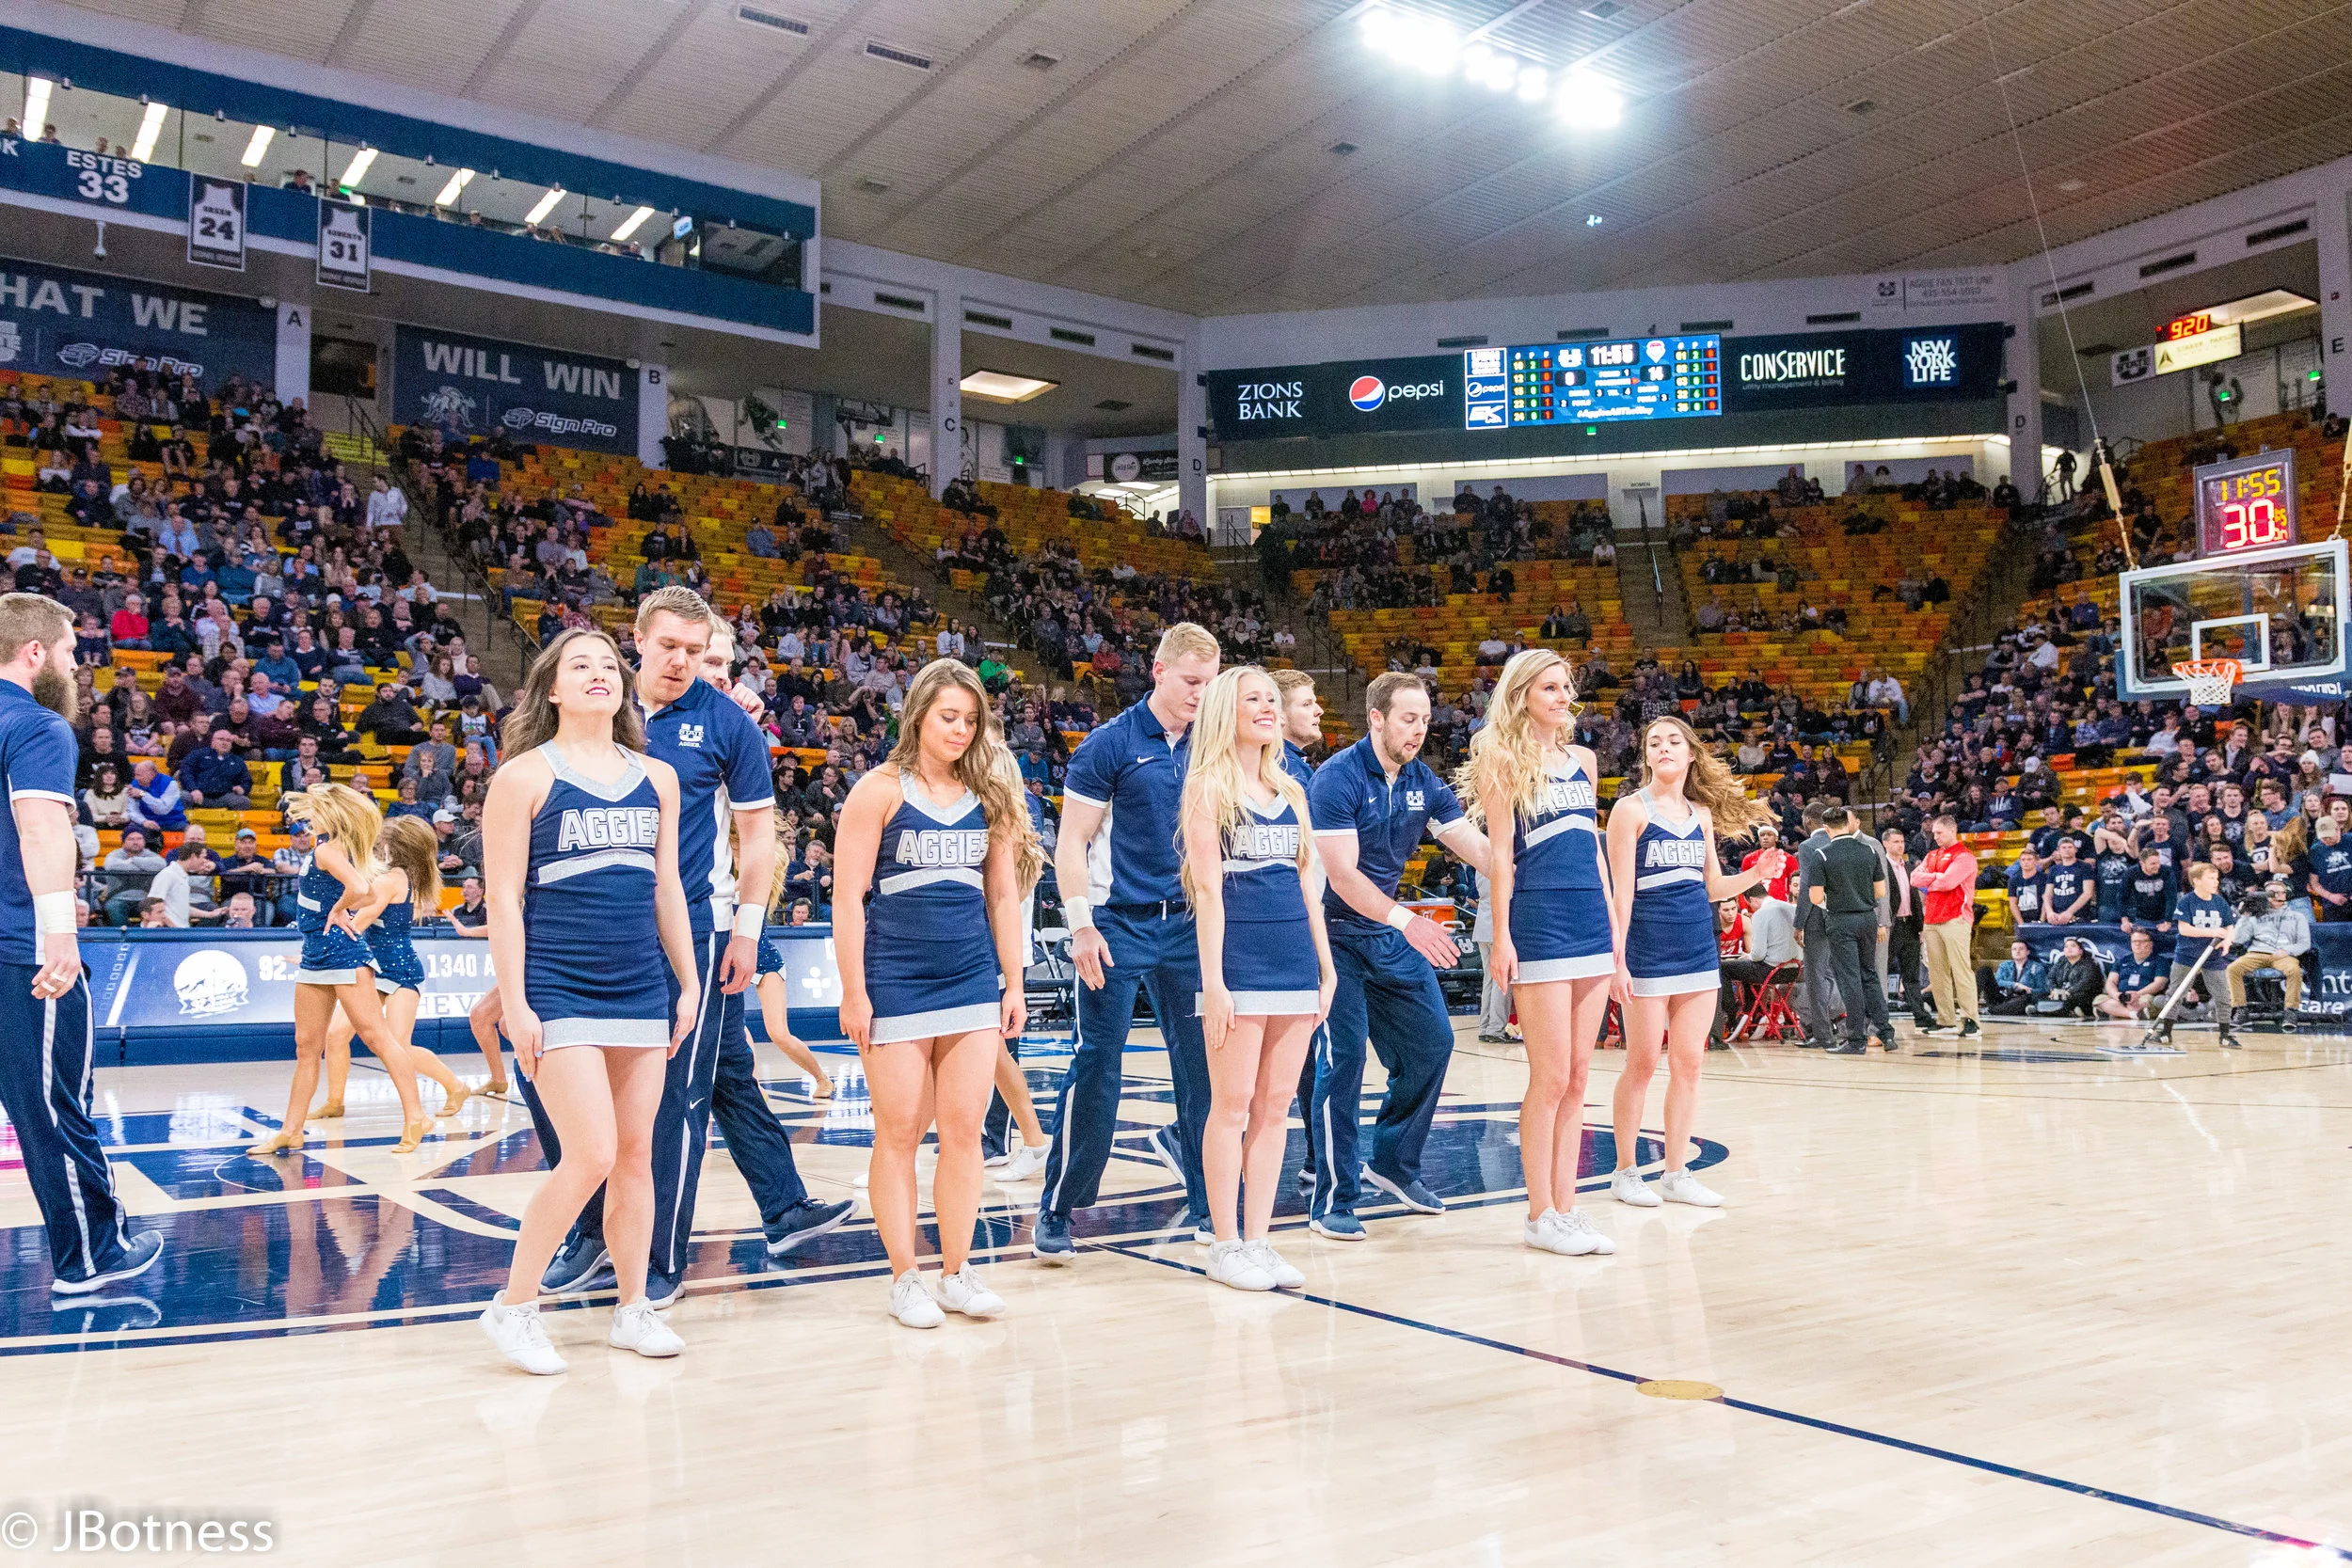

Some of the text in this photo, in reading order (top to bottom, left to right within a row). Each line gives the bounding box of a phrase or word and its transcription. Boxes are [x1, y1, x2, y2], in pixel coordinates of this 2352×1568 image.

[66, 150, 143, 179] ESTES
[77, 169, 130, 203] 33
[199, 216, 235, 241] 24
[329, 240, 358, 262] 31
[131, 293, 208, 337] WE
[287, 310, 302, 327] A
[1590, 343, 1634, 366] 11:55
[1911, 340, 1951, 357] NEW
[2331, 336, 2344, 354] E
[423, 341, 621, 400] WILL WIN
[1740, 348, 1846, 382] CONSERVICE
[1904, 352, 1957, 370] YORK
[649, 369, 660, 385] B
[1913, 365, 1952, 383] LIFE
[1237, 381, 1303, 401] ZIONS
[1389, 380, 1443, 402] pepsi
[1238, 401, 1302, 420] BANK
[2015, 415, 2026, 428] D
[534, 412, 617, 437] Sign Pro
[945, 418, 956, 432] C
[1193, 458, 1202, 471] D
[2221, 468, 2280, 501] 11:55
[2223, 499, 2276, 548] 30
[678, 728, 705, 737] STATE
[1534, 781, 1597, 816] AGGIE
[1232, 825, 1301, 859] AGGIE
[1645, 839, 1705, 867] AGGIE
[425, 953, 477, 978] 1340
